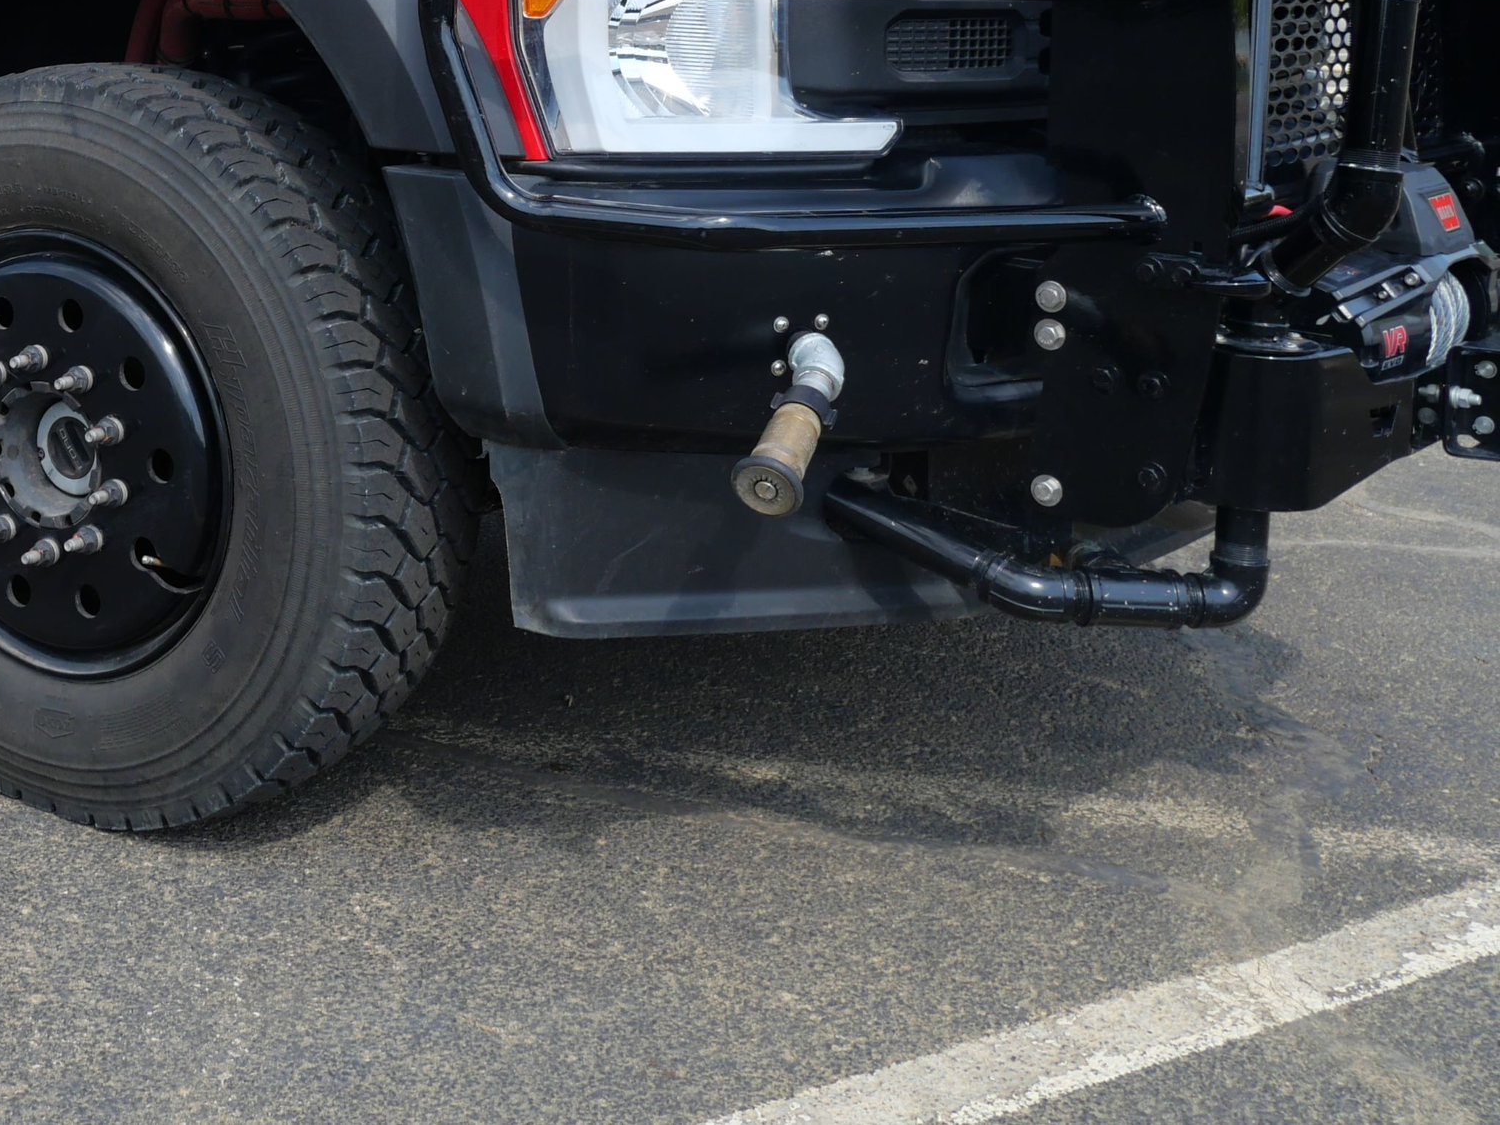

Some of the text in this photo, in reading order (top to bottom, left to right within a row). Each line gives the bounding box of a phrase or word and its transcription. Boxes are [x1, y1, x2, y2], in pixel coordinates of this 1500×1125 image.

[1436, 204, 1455, 221] WARN
[1382, 325, 1407, 358] VR
[1382, 355, 1404, 370] EVO
[58, 428, 83, 471] FORD
